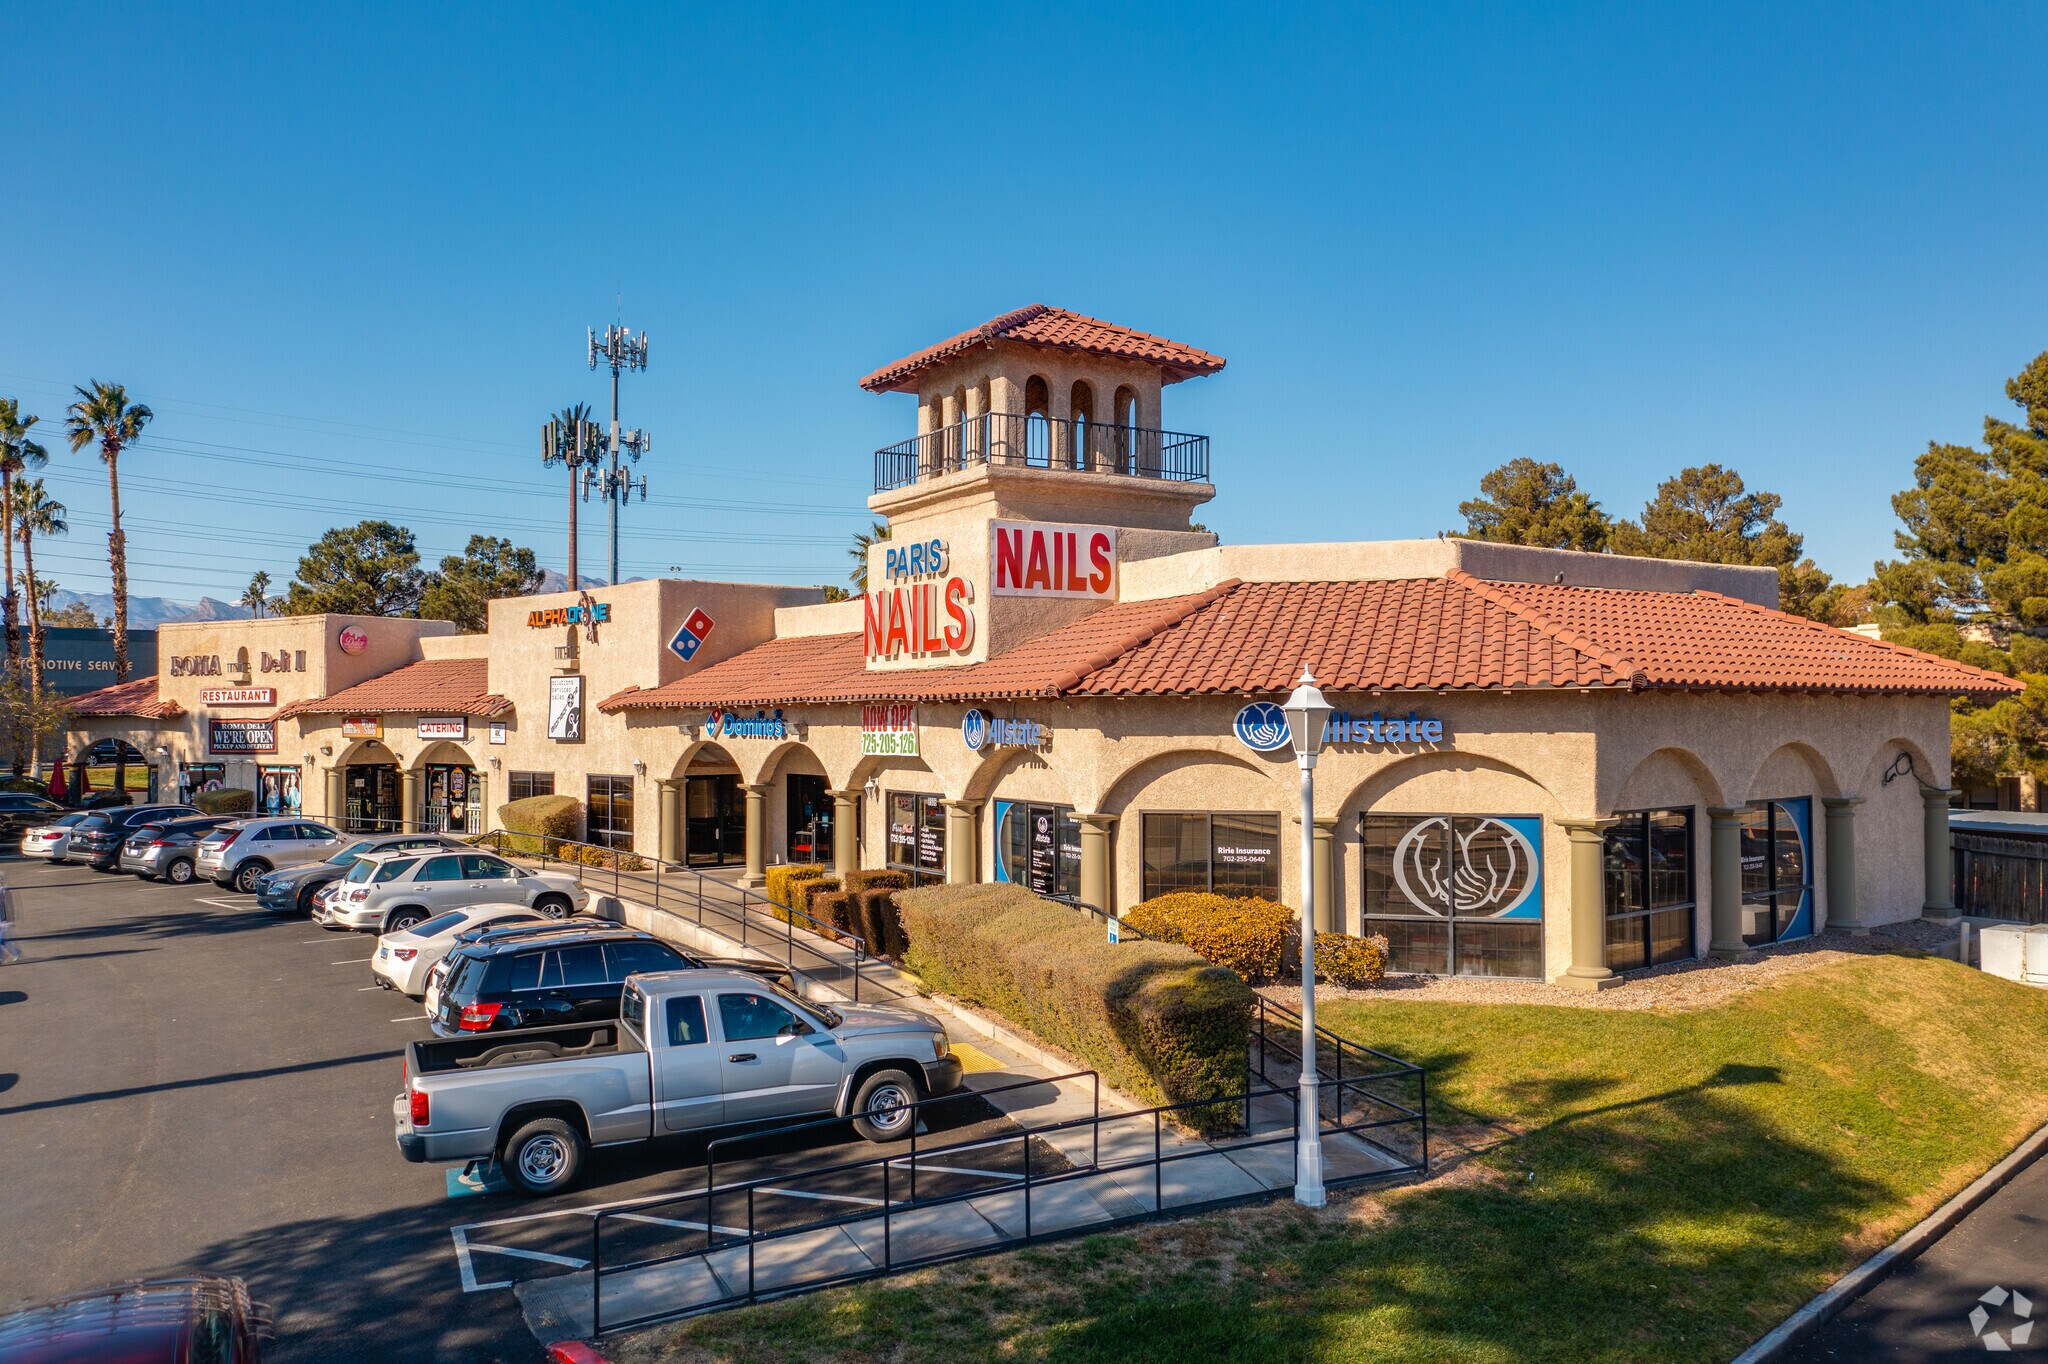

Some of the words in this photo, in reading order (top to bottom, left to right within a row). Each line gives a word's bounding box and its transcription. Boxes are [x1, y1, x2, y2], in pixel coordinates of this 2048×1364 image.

[886, 538, 943, 580] PARIS
[997, 527, 1112, 594] NAILS
[527, 603, 607, 626] ALPHADRNE
[864, 577, 970, 657] NAILS
[4, 660, 82, 670] ATOOTIVE
[88, 661, 133, 671] SERVE
[170, 655, 222, 676] ROMA
[202, 691, 268, 702] RESTAURANT
[420, 722, 462, 733] CATERING
[862, 704, 889, 732] NOW
[891, 704, 916, 732] OPE
[1323, 711, 1443, 743] llstate
[214, 730, 245, 744] WE'RE
[247, 730, 274, 744] OPEN
[987, 718, 1041, 745] Allstate
[1235, 847, 1271, 855] Insurance
